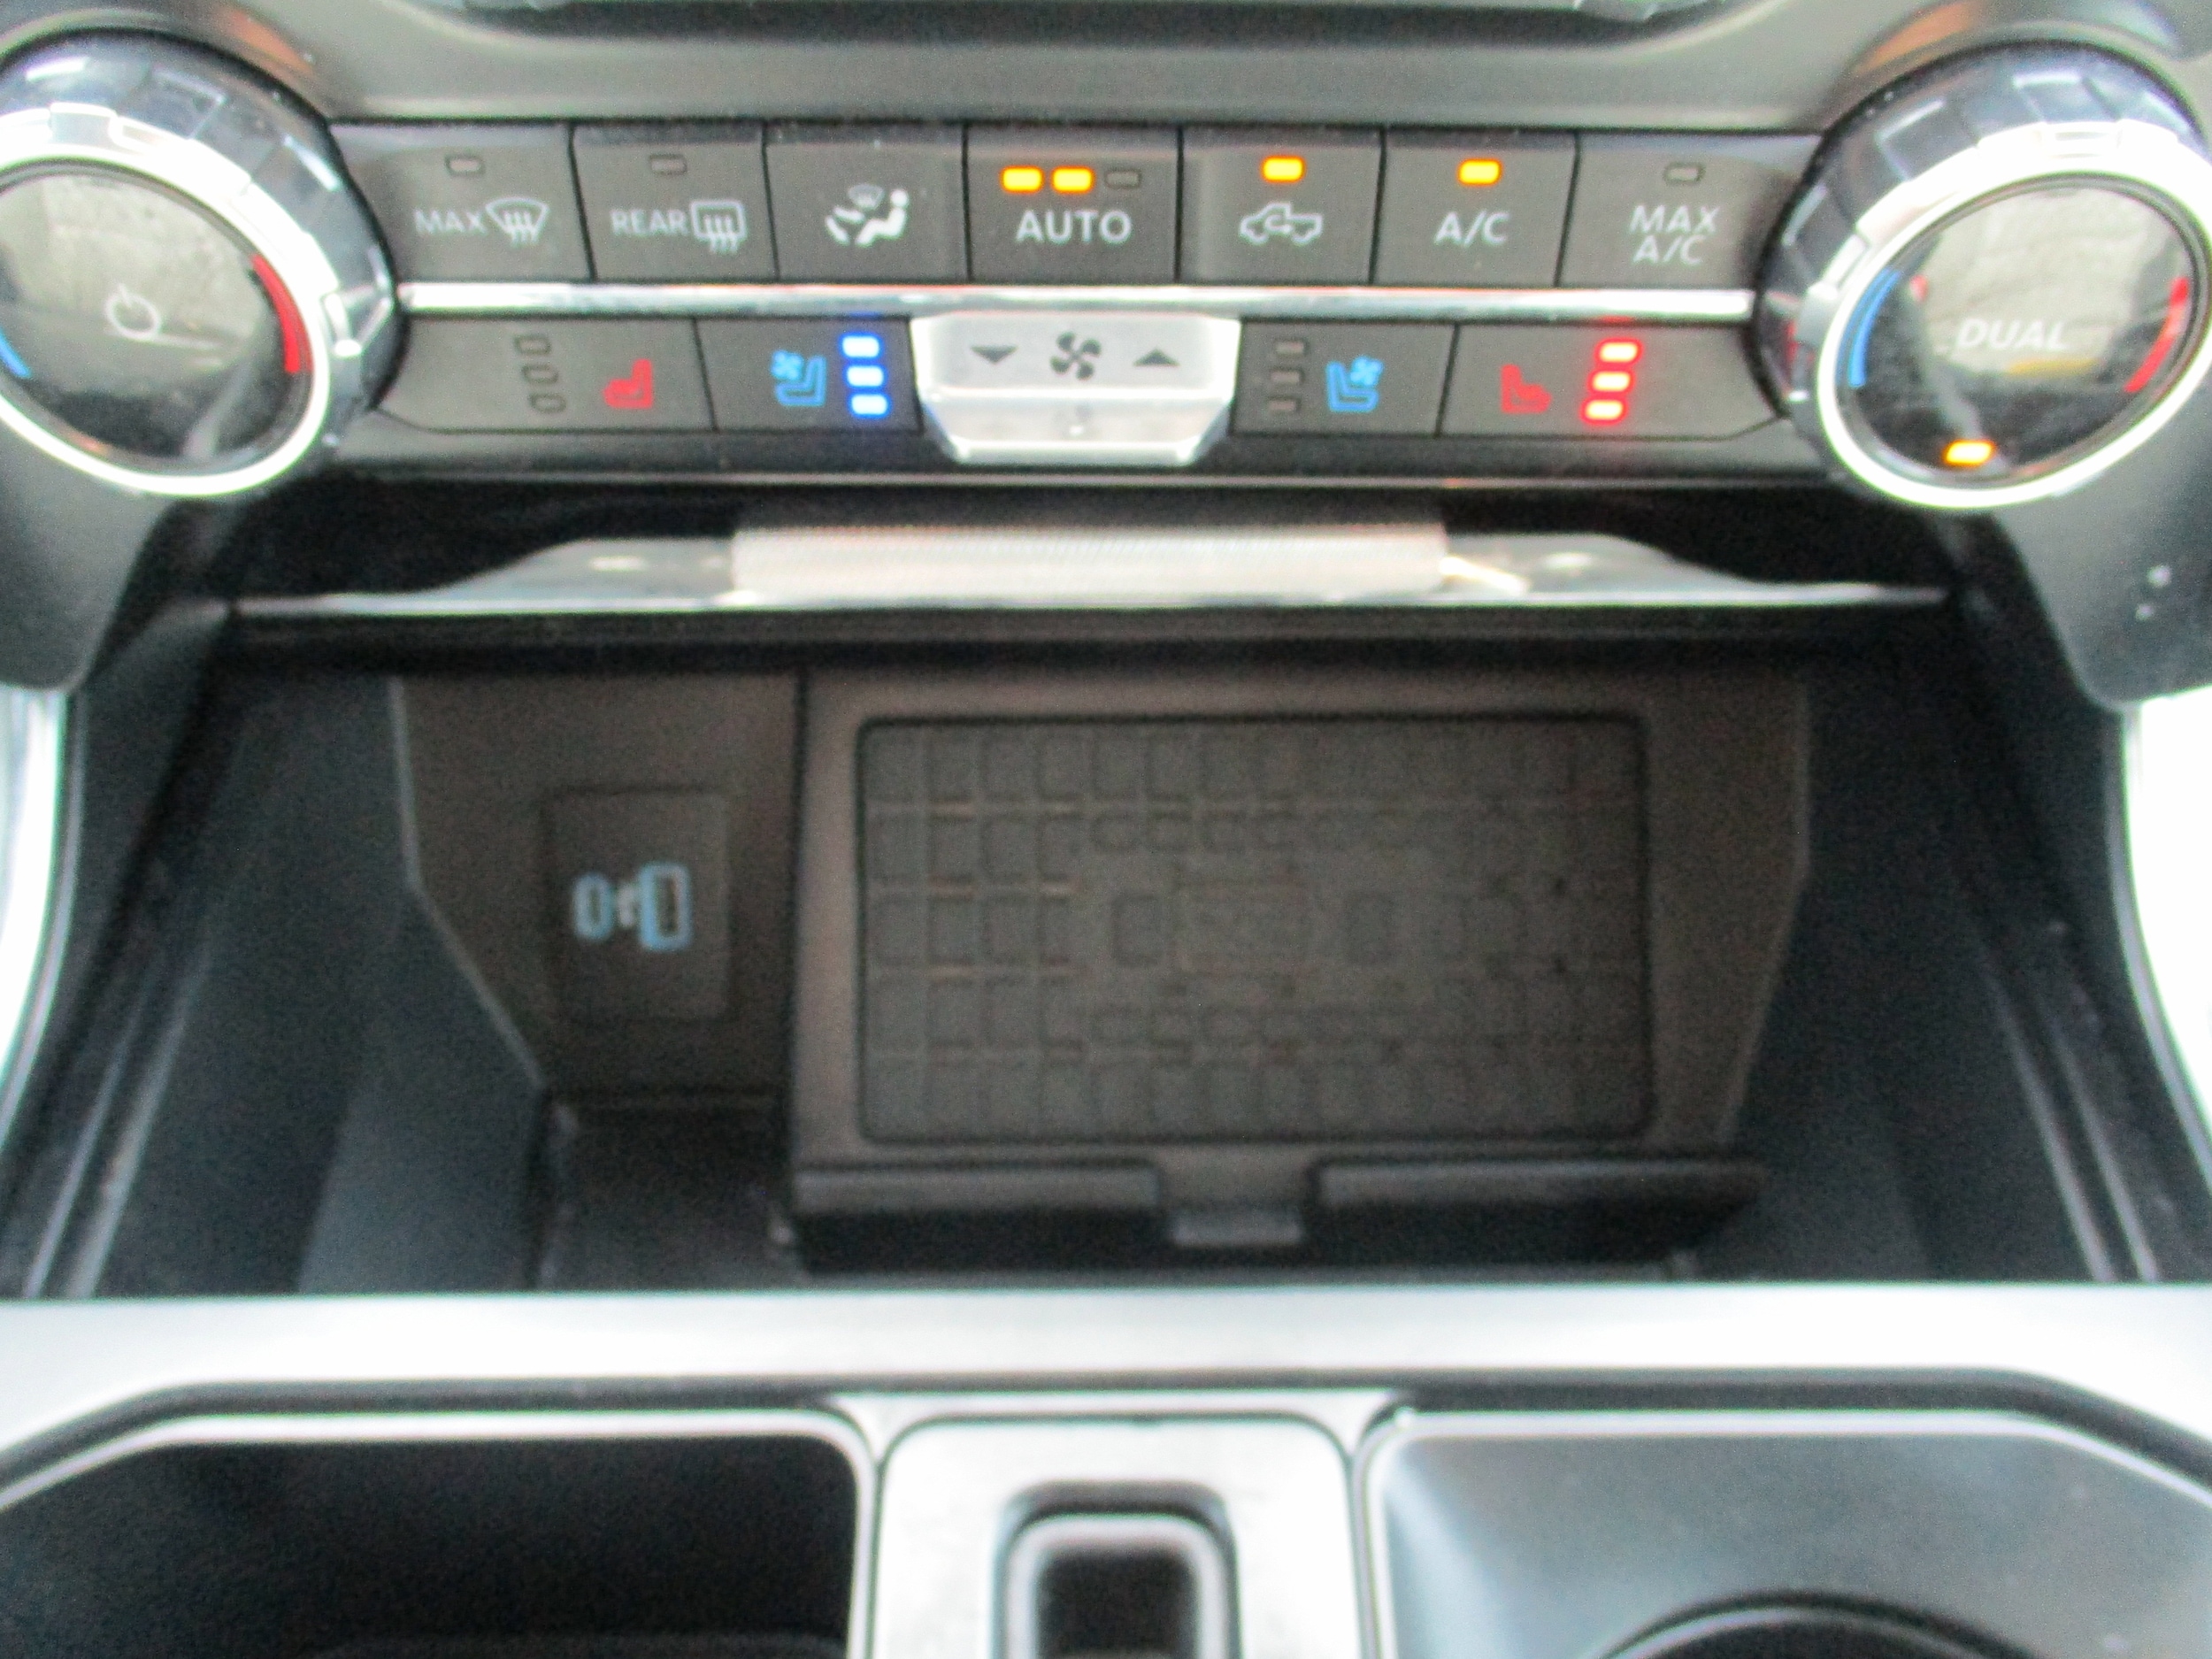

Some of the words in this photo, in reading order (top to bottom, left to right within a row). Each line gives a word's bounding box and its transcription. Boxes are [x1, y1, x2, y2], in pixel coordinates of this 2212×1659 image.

[414, 209, 486, 236] MAX
[611, 209, 687, 235] REAR
[1017, 210, 1133, 244] AUTO
[1434, 210, 1510, 246] A/C
[1630, 204, 1719, 233] MAX
[1633, 235, 1704, 265] A/C
[1956, 319, 2068, 351] DUAL
